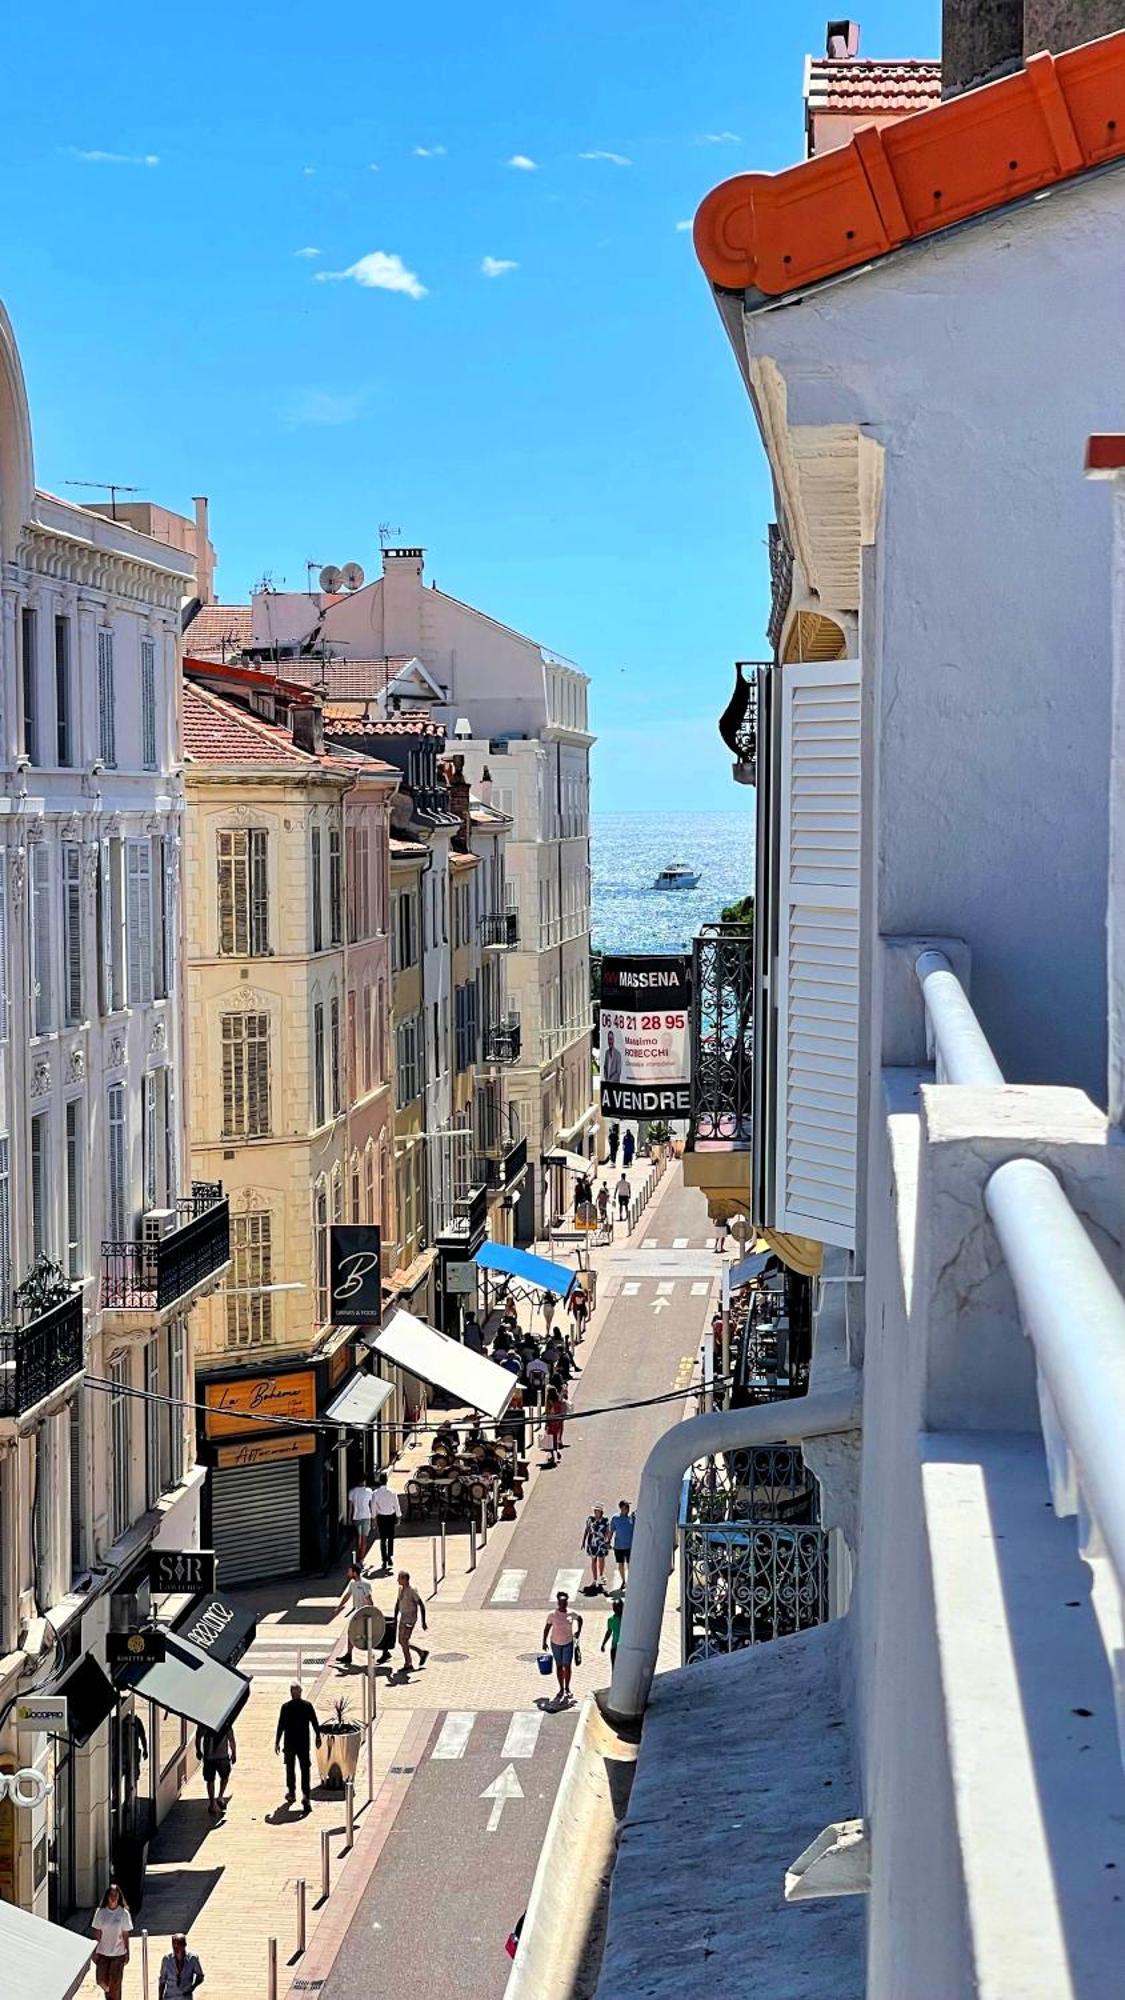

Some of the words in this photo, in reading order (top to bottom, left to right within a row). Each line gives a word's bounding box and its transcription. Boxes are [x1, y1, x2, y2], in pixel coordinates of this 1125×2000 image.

[619, 971, 680, 988] MASSENA
[602, 1013, 612, 1028] 06
[613, 1014, 625, 1030] 48
[626, 1016, 637, 1030] 21
[641, 1016, 661, 1030] 28
[665, 1015, 685, 1030] 95
[625, 1036, 658, 1046] Massimo
[612, 1090, 691, 1110] VENDRE
[333, 1251, 378, 1300] B
[218, 1386, 239, 1409] La
[159, 1555, 202, 1582] SIR
